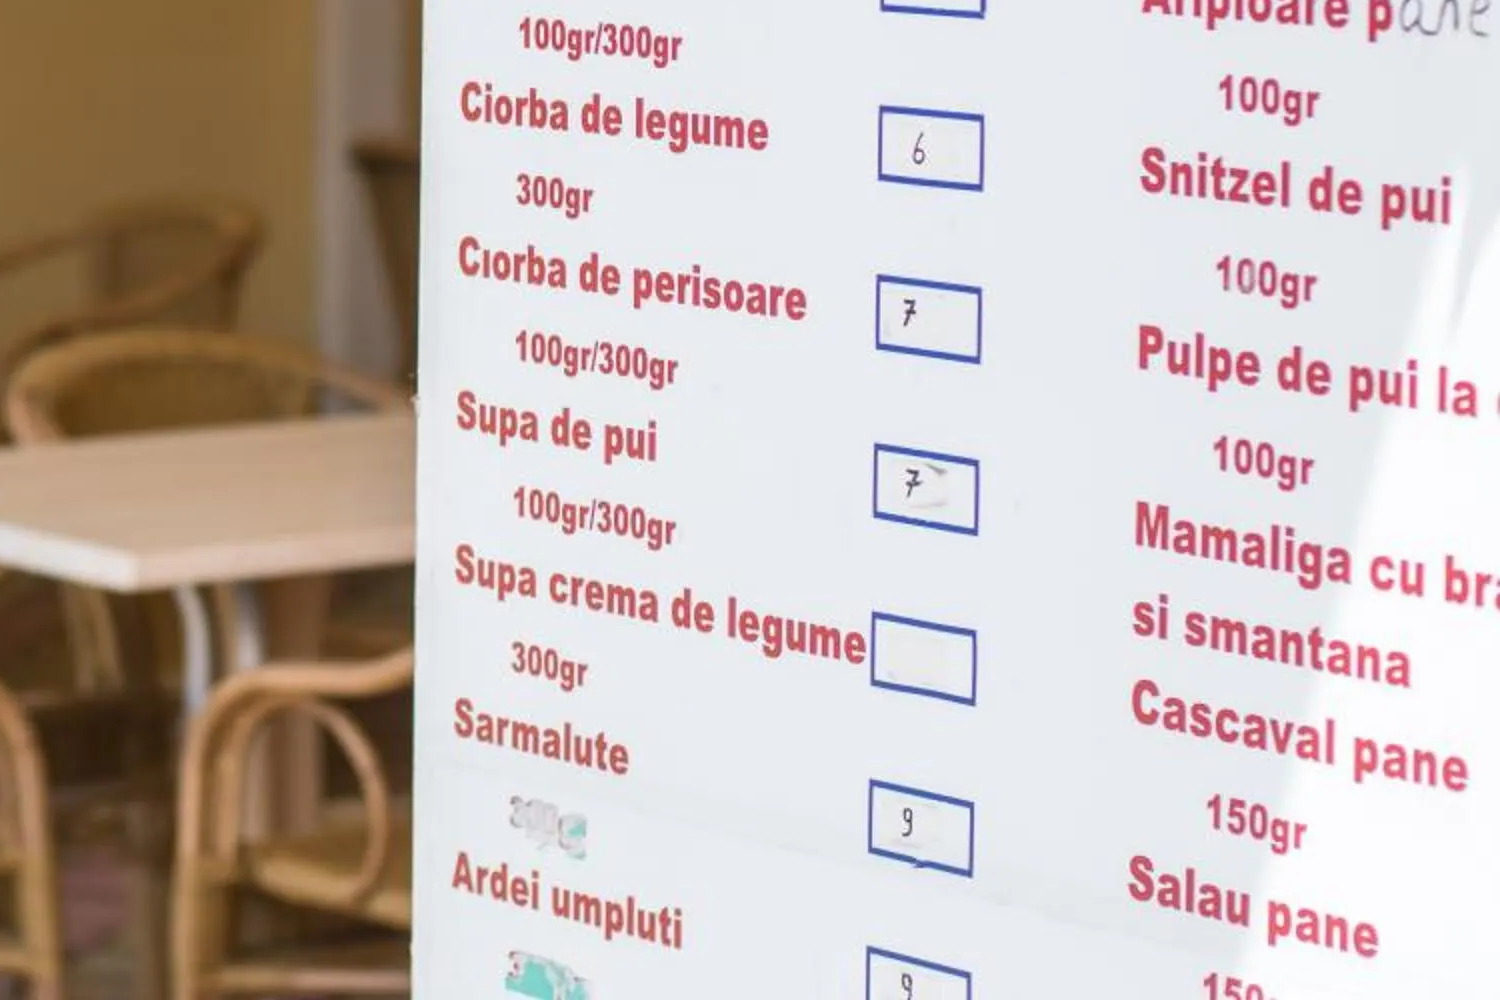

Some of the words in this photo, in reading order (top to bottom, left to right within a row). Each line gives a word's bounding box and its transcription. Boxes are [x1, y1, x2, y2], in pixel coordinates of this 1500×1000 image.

[519, 17, 683, 69] 100gr/300gr
[459, 80, 569, 131] Ciorba
[580, 93, 623, 136] de
[635, 97, 769, 154] legume
[1219, 75, 1320, 128] 100gr
[913, 132, 926, 165] 6
[516, 173, 593, 219] 300gr
[1140, 146, 1291, 208] Snitzel
[1308, 165, 1362, 215] de
[1380, 176, 1451, 231] pui
[458, 236, 567, 289] Ciorba
[579, 252, 621, 295] de
[632, 264, 807, 321] perisoare
[1216, 255, 1317, 310] 100gr
[903, 299, 917, 327] 7
[515, 330, 679, 391] 100gr/300gr
[1138, 324, 1261, 393] Pulpe
[1276, 346, 1333, 396] de
[1348, 358, 1418, 413] pui
[1438, 367, 1478, 417] la
[457, 391, 539, 447] Supa
[551, 407, 592, 450] de
[603, 420, 657, 465] pui
[905, 469, 922, 497] 7
[1213, 436, 1314, 493] 100gr
[513, 487, 676, 551] 100gr/300gr
[1135, 501, 1352, 591] Mamaliga
[1369, 555, 1425, 597] cu
[1443, 554, 1500, 611] br
[455, 544, 537, 601] Supa
[548, 573, 658, 623] crema
[671, 588, 715, 633] de
[727, 597, 866, 664] legume
[512, 642, 588, 692] 300gr
[1132, 593, 1169, 640] si
[1185, 612, 1411, 688] smantana
[454, 698, 629, 775] Sarmalute
[1131, 679, 1336, 764] Cascaval
[1353, 737, 1469, 792] pane
[901, 807, 913, 837] 9
[1207, 794, 1307, 855] 150gr
[452, 852, 539, 910] Ardei
[551, 887, 682, 949] umpluti
[1128, 855, 1250, 927] Salau
[1267, 901, 1378, 958] pane
